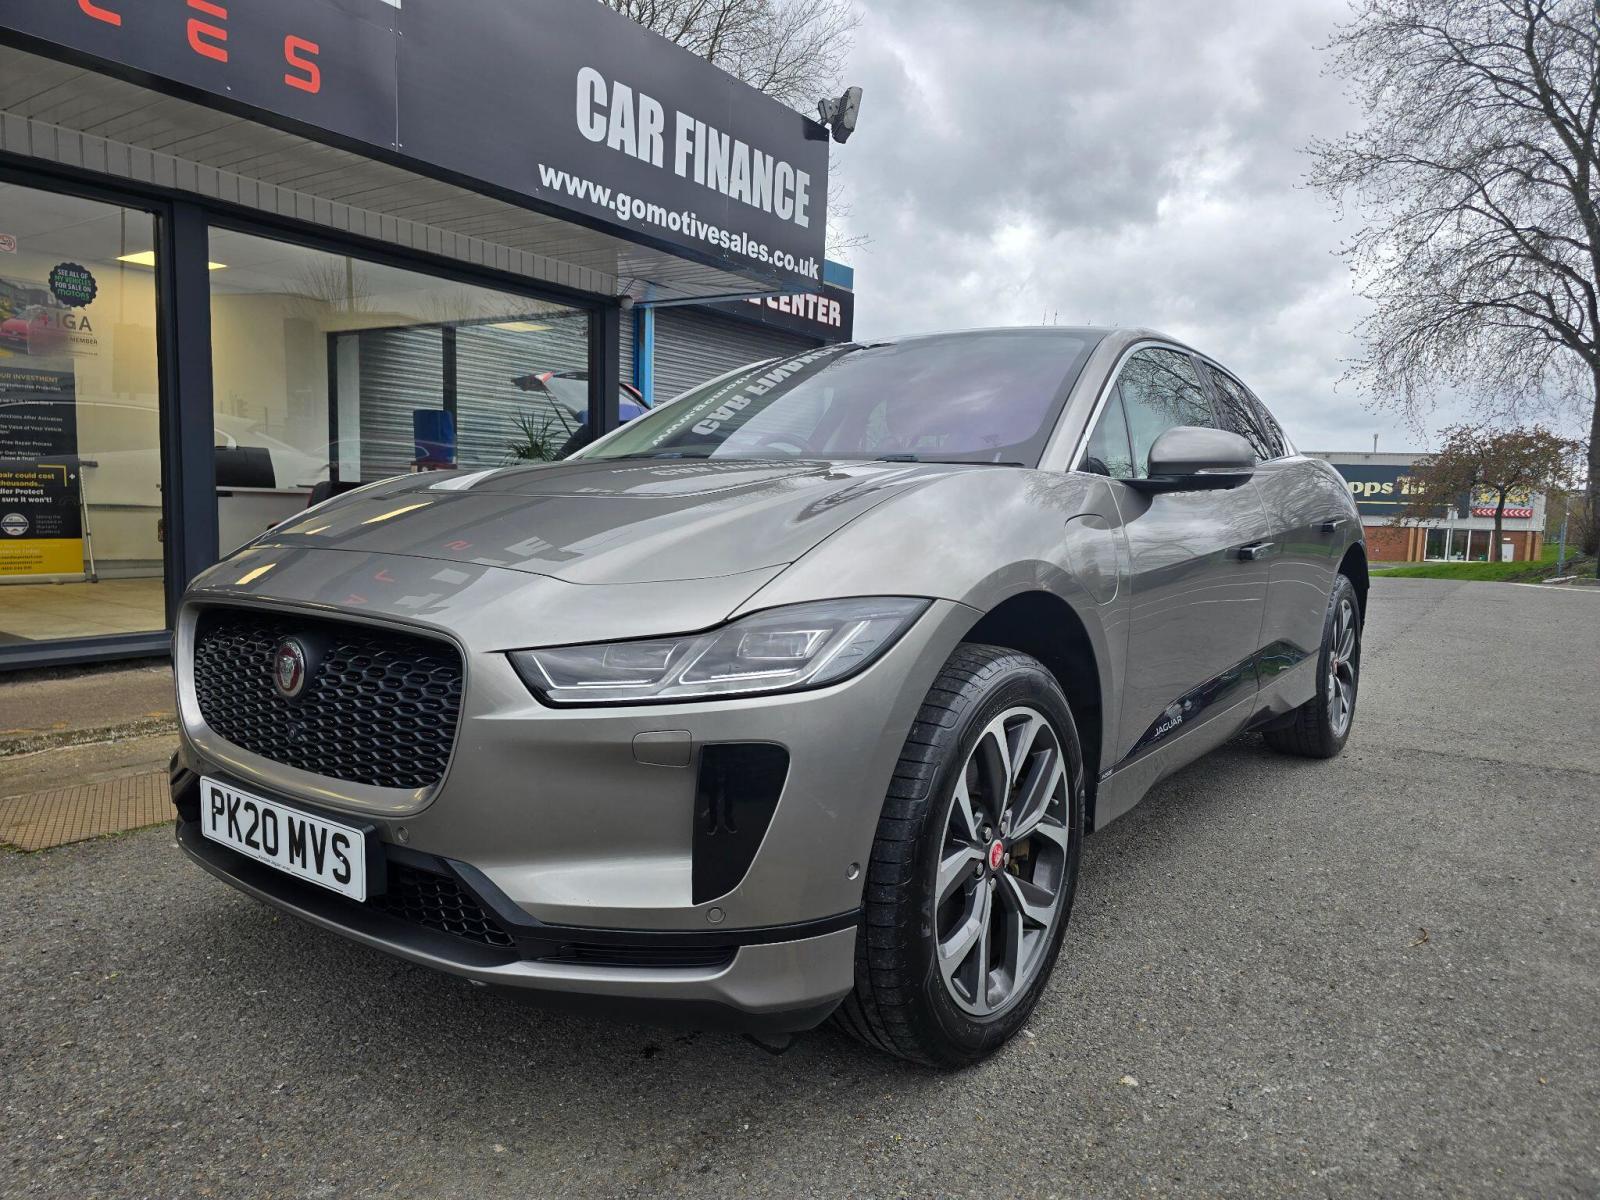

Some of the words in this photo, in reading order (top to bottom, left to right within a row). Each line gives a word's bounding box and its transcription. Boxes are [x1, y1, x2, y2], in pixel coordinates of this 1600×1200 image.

[576, 66, 665, 168] CAR
[674, 110, 811, 229] FINANCE
[538, 163, 819, 280] www.gomotivesales.co.uk
[57, 269, 68, 277] SEE
[69, 270, 80, 279] ALL
[80, 272, 88, 280] OF
[65, 276, 91, 286] VEHICLES
[55, 281, 67, 290] FOR
[68, 283, 81, 291] SALE
[55, 311, 93, 332] IGA
[13, 373, 58, 383] INVESTMENT
[15, 488, 44, 496] Protect
[1154, 715, 1183, 737] JAGUAR
[210, 786, 279, 857] PK20
[287, 815, 352, 885] MVS
